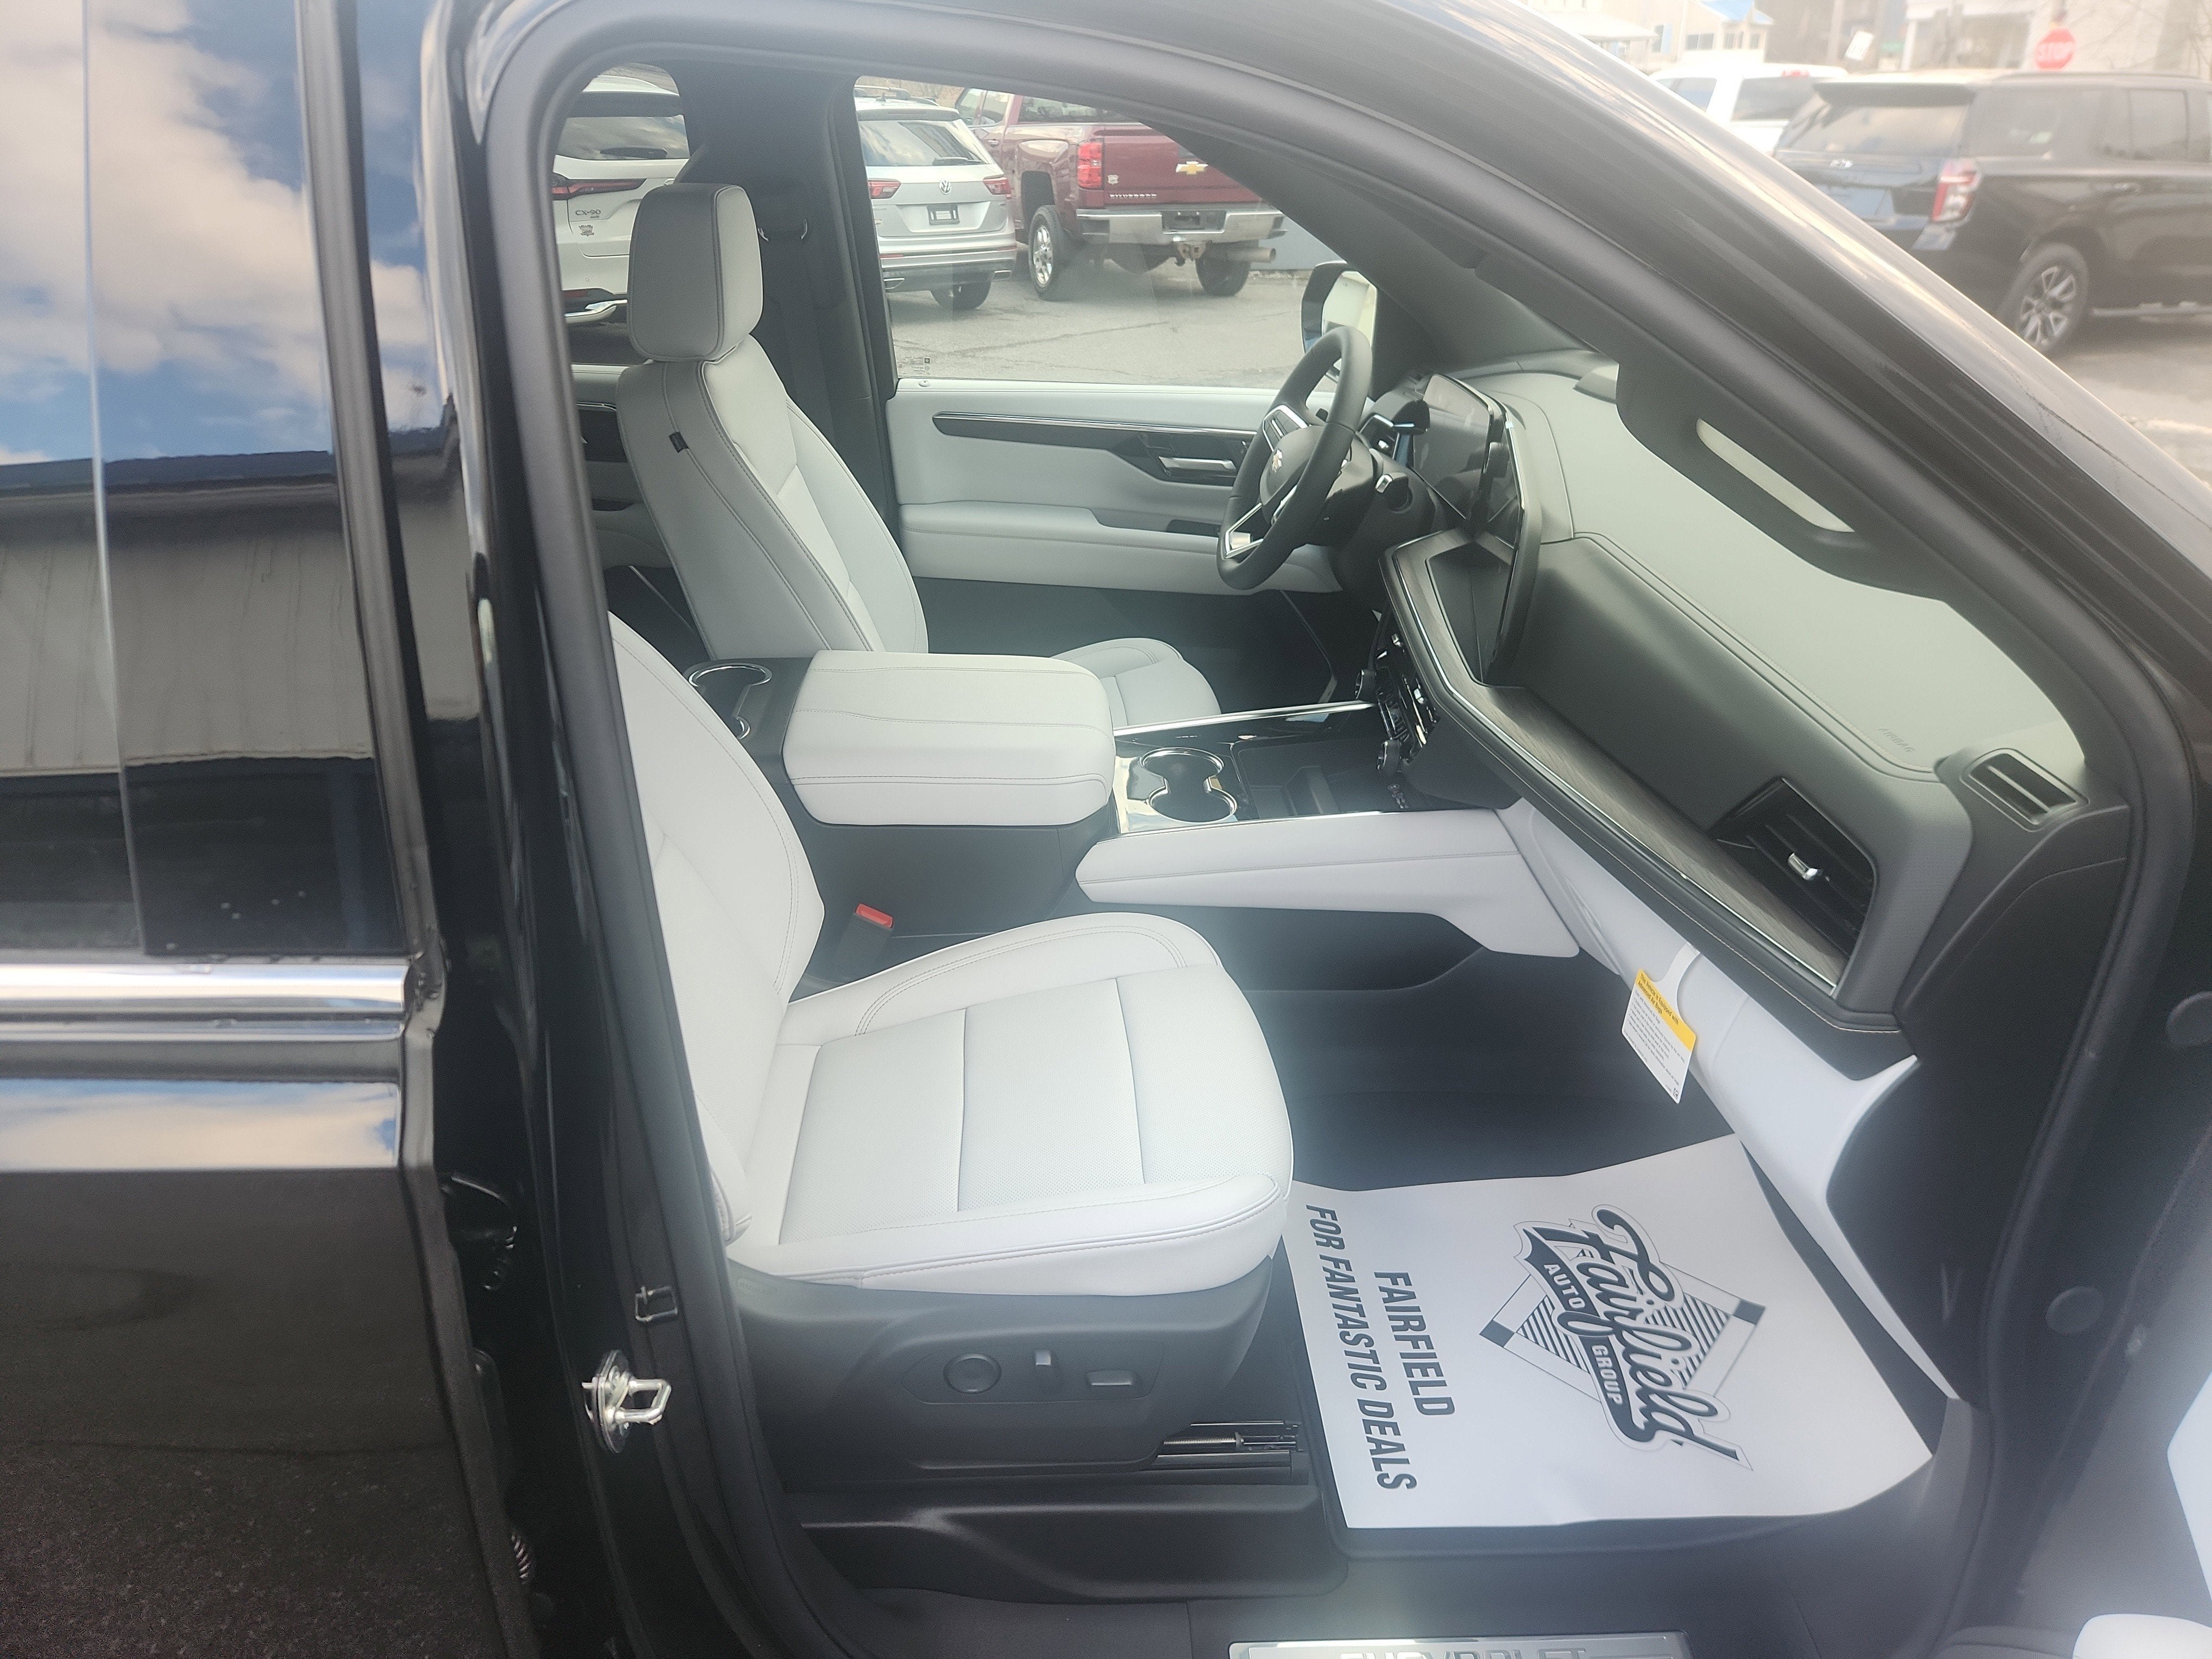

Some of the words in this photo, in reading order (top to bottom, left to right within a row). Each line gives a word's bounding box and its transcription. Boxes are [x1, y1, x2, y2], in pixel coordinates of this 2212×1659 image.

[1875, 728, 1917, 753] AIRBAG
[1306, 1204, 1346, 1250] FOR
[1319, 1253, 1387, 1391] FANTASTIC
[1373, 1271, 1455, 1416] FAIRFIELD
[1543, 1263, 1586, 1310] AUTO
[1591, 1344, 1623, 1406] GROUP
[1356, 1398, 1417, 1489] DEALS
